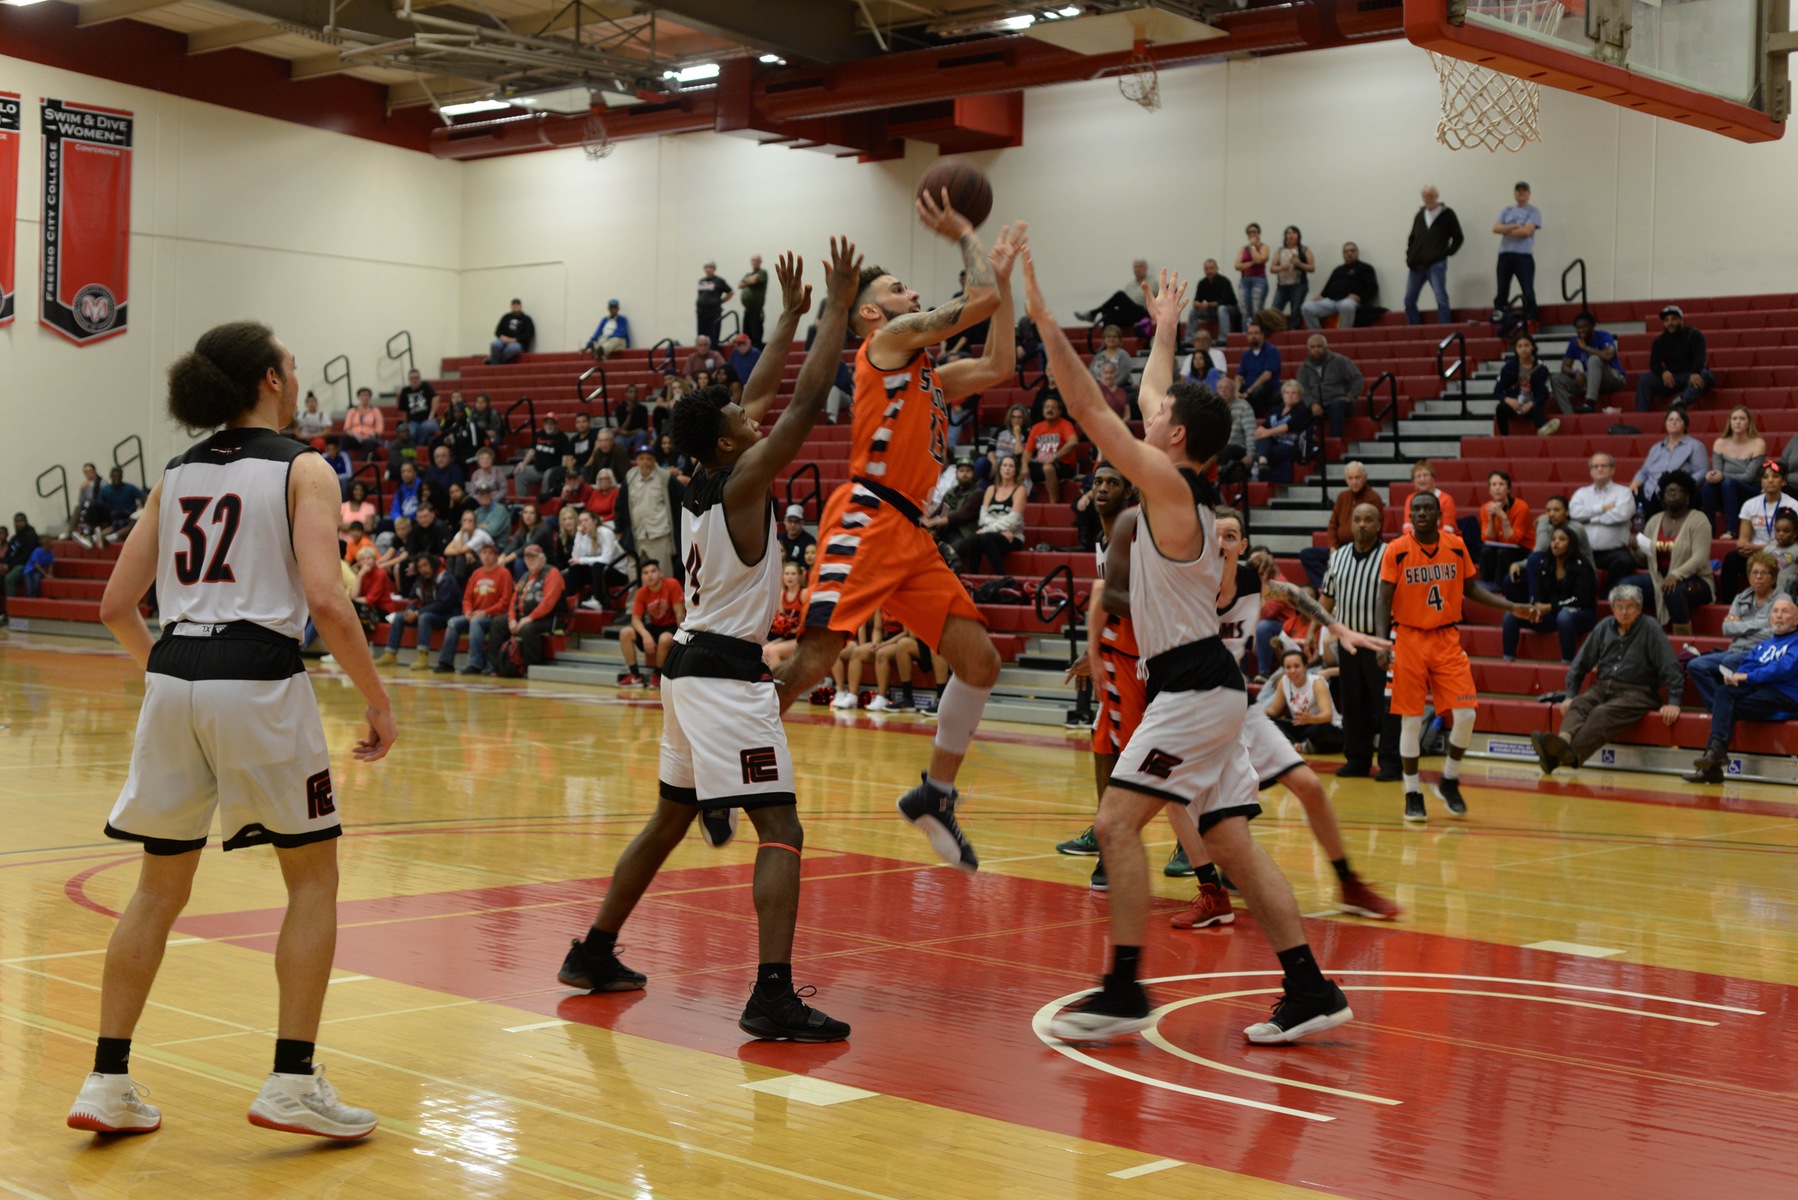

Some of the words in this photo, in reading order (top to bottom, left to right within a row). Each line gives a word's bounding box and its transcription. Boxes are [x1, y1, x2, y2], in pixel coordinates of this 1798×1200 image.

[83, 114, 95, 126] &
[47, 142, 58, 205] COLLEGE
[46, 210, 57, 241] CITY
[46, 246, 56, 301] FRESNO
[174, 493, 242, 586] 32
[1405, 562, 1457, 585] SEQUOIAS
[1427, 584, 1444, 612] 4
